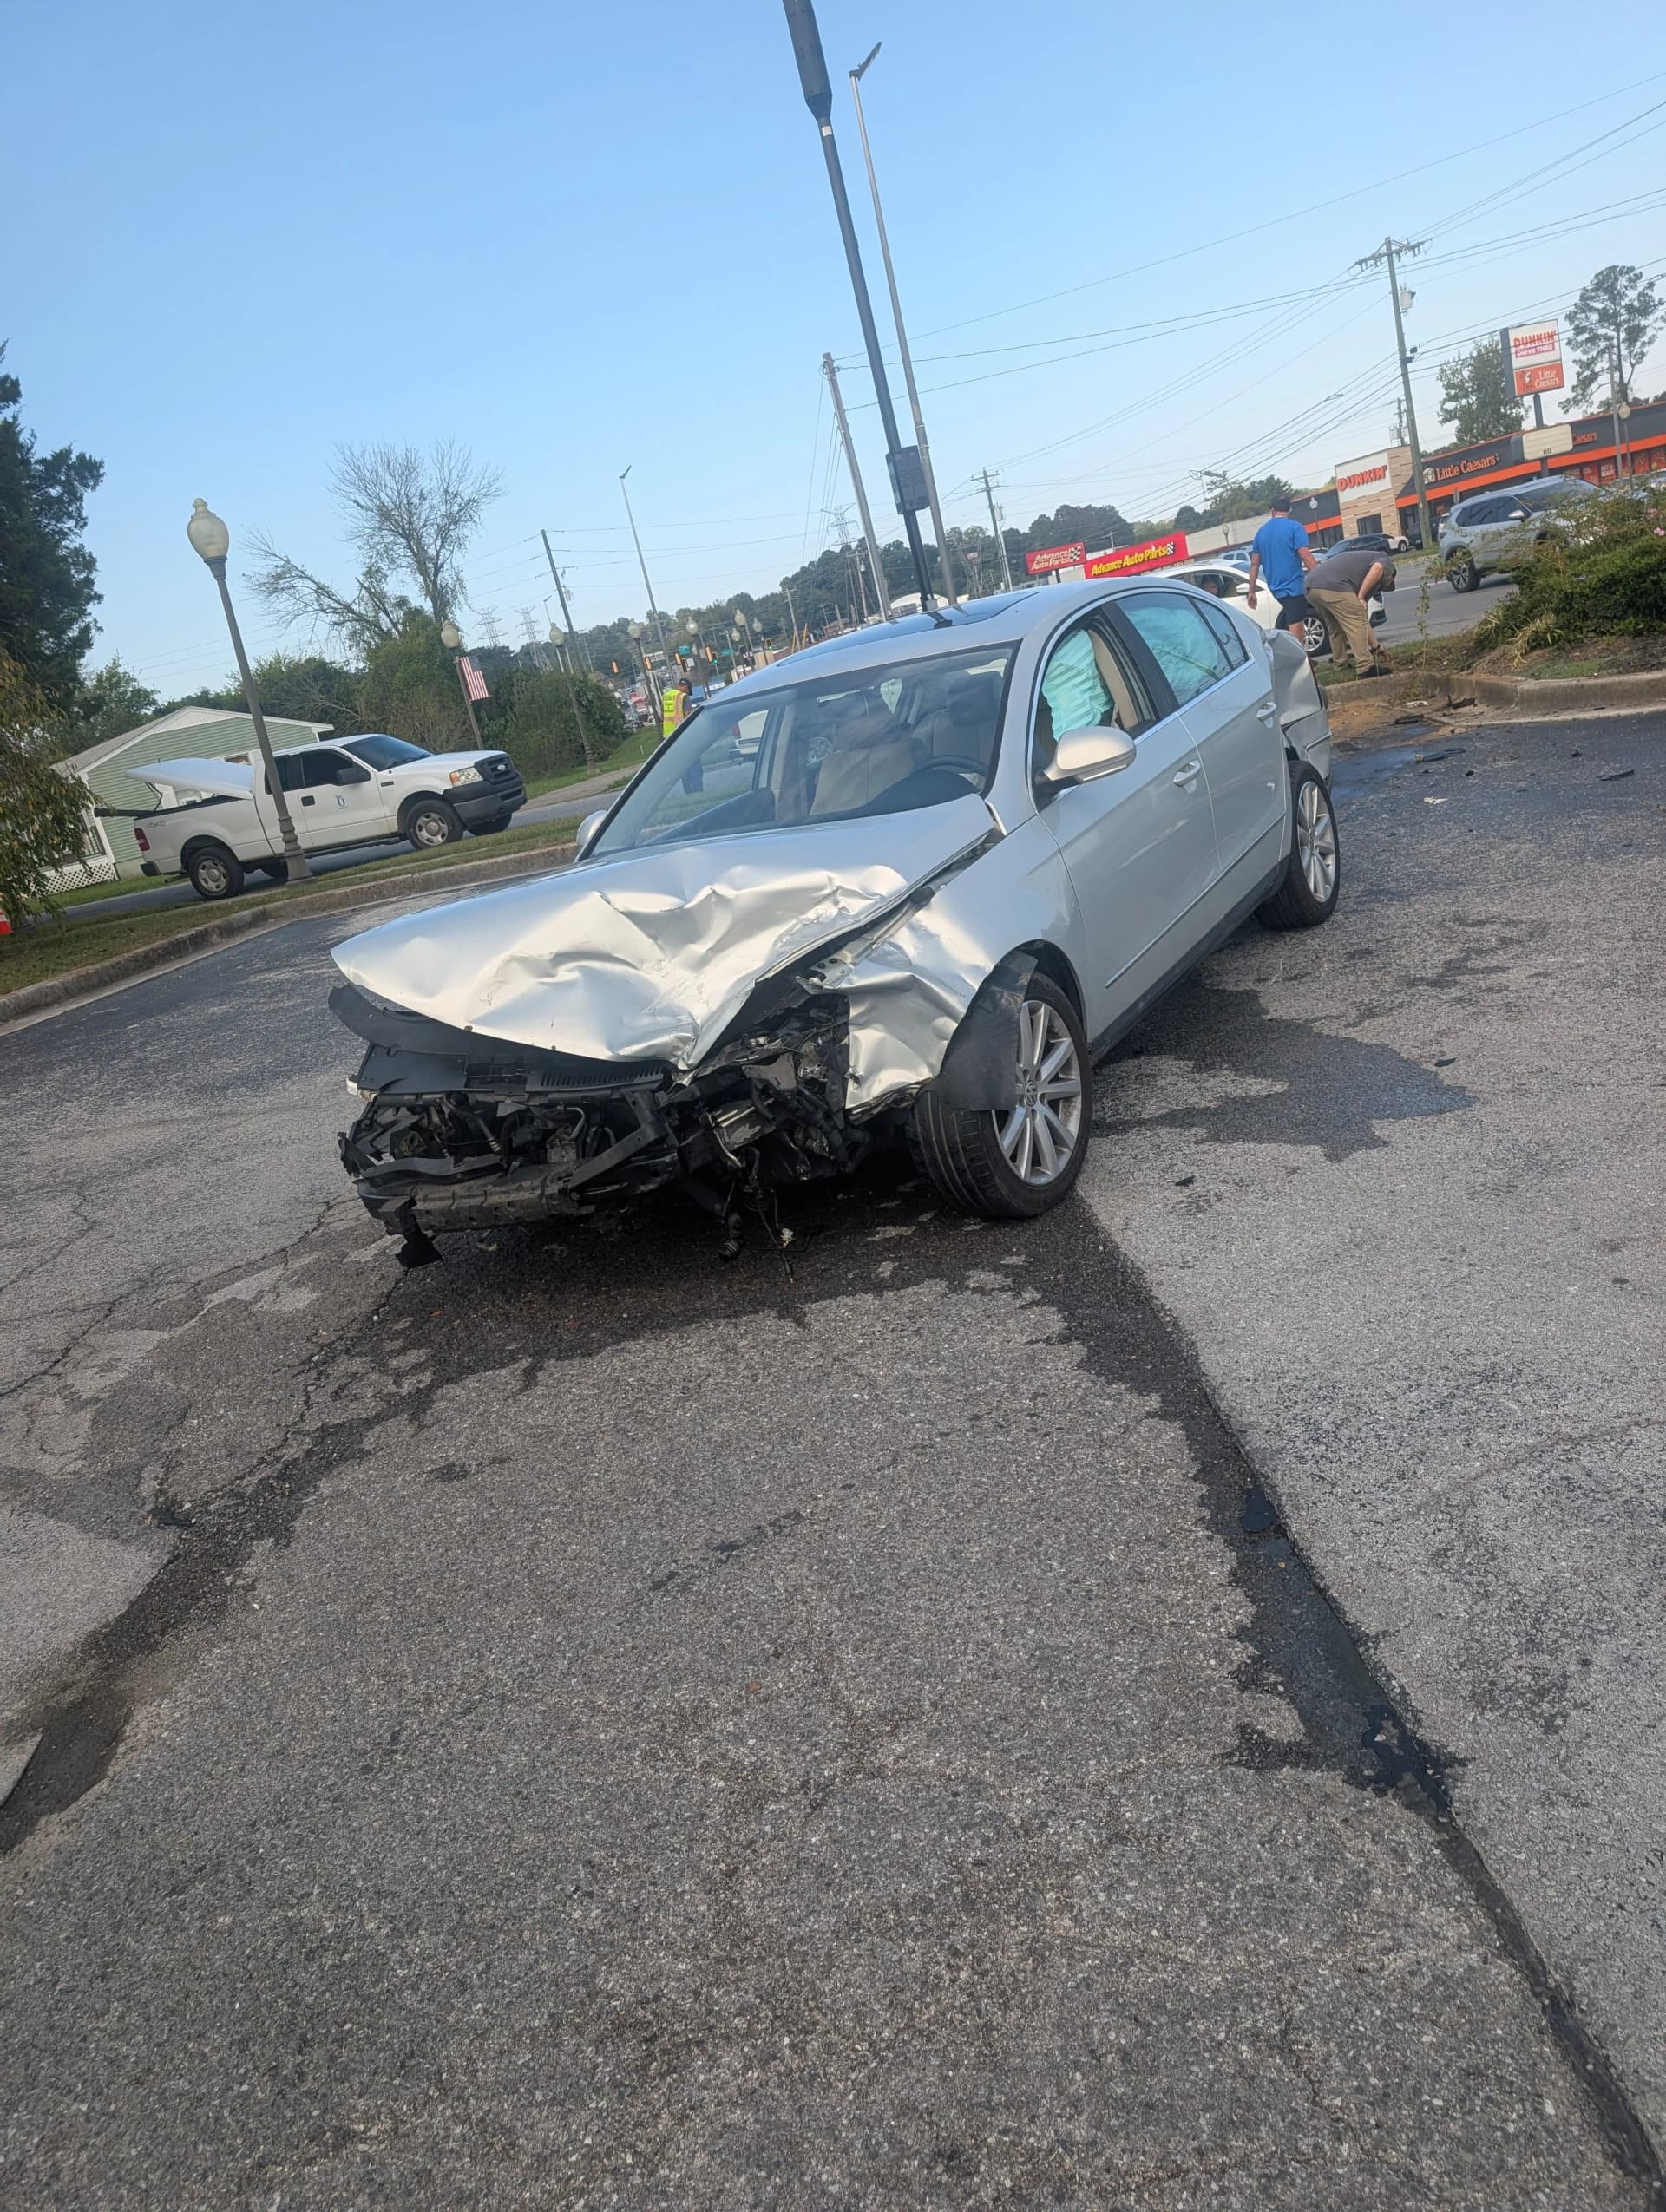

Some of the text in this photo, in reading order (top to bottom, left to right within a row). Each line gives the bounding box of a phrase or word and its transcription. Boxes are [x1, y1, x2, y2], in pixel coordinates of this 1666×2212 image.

[1539, 369, 1556, 380] Little
[1535, 377, 1559, 389] Caesars
[1436, 455, 1496, 481] Little Caesars
[1337, 465, 1387, 491] DUNKIN'
[1031, 555, 1068, 571] Auto Parts
[1035, 550, 1068, 562] Advance
[1091, 546, 1167, 577] Advance Auto Parts
